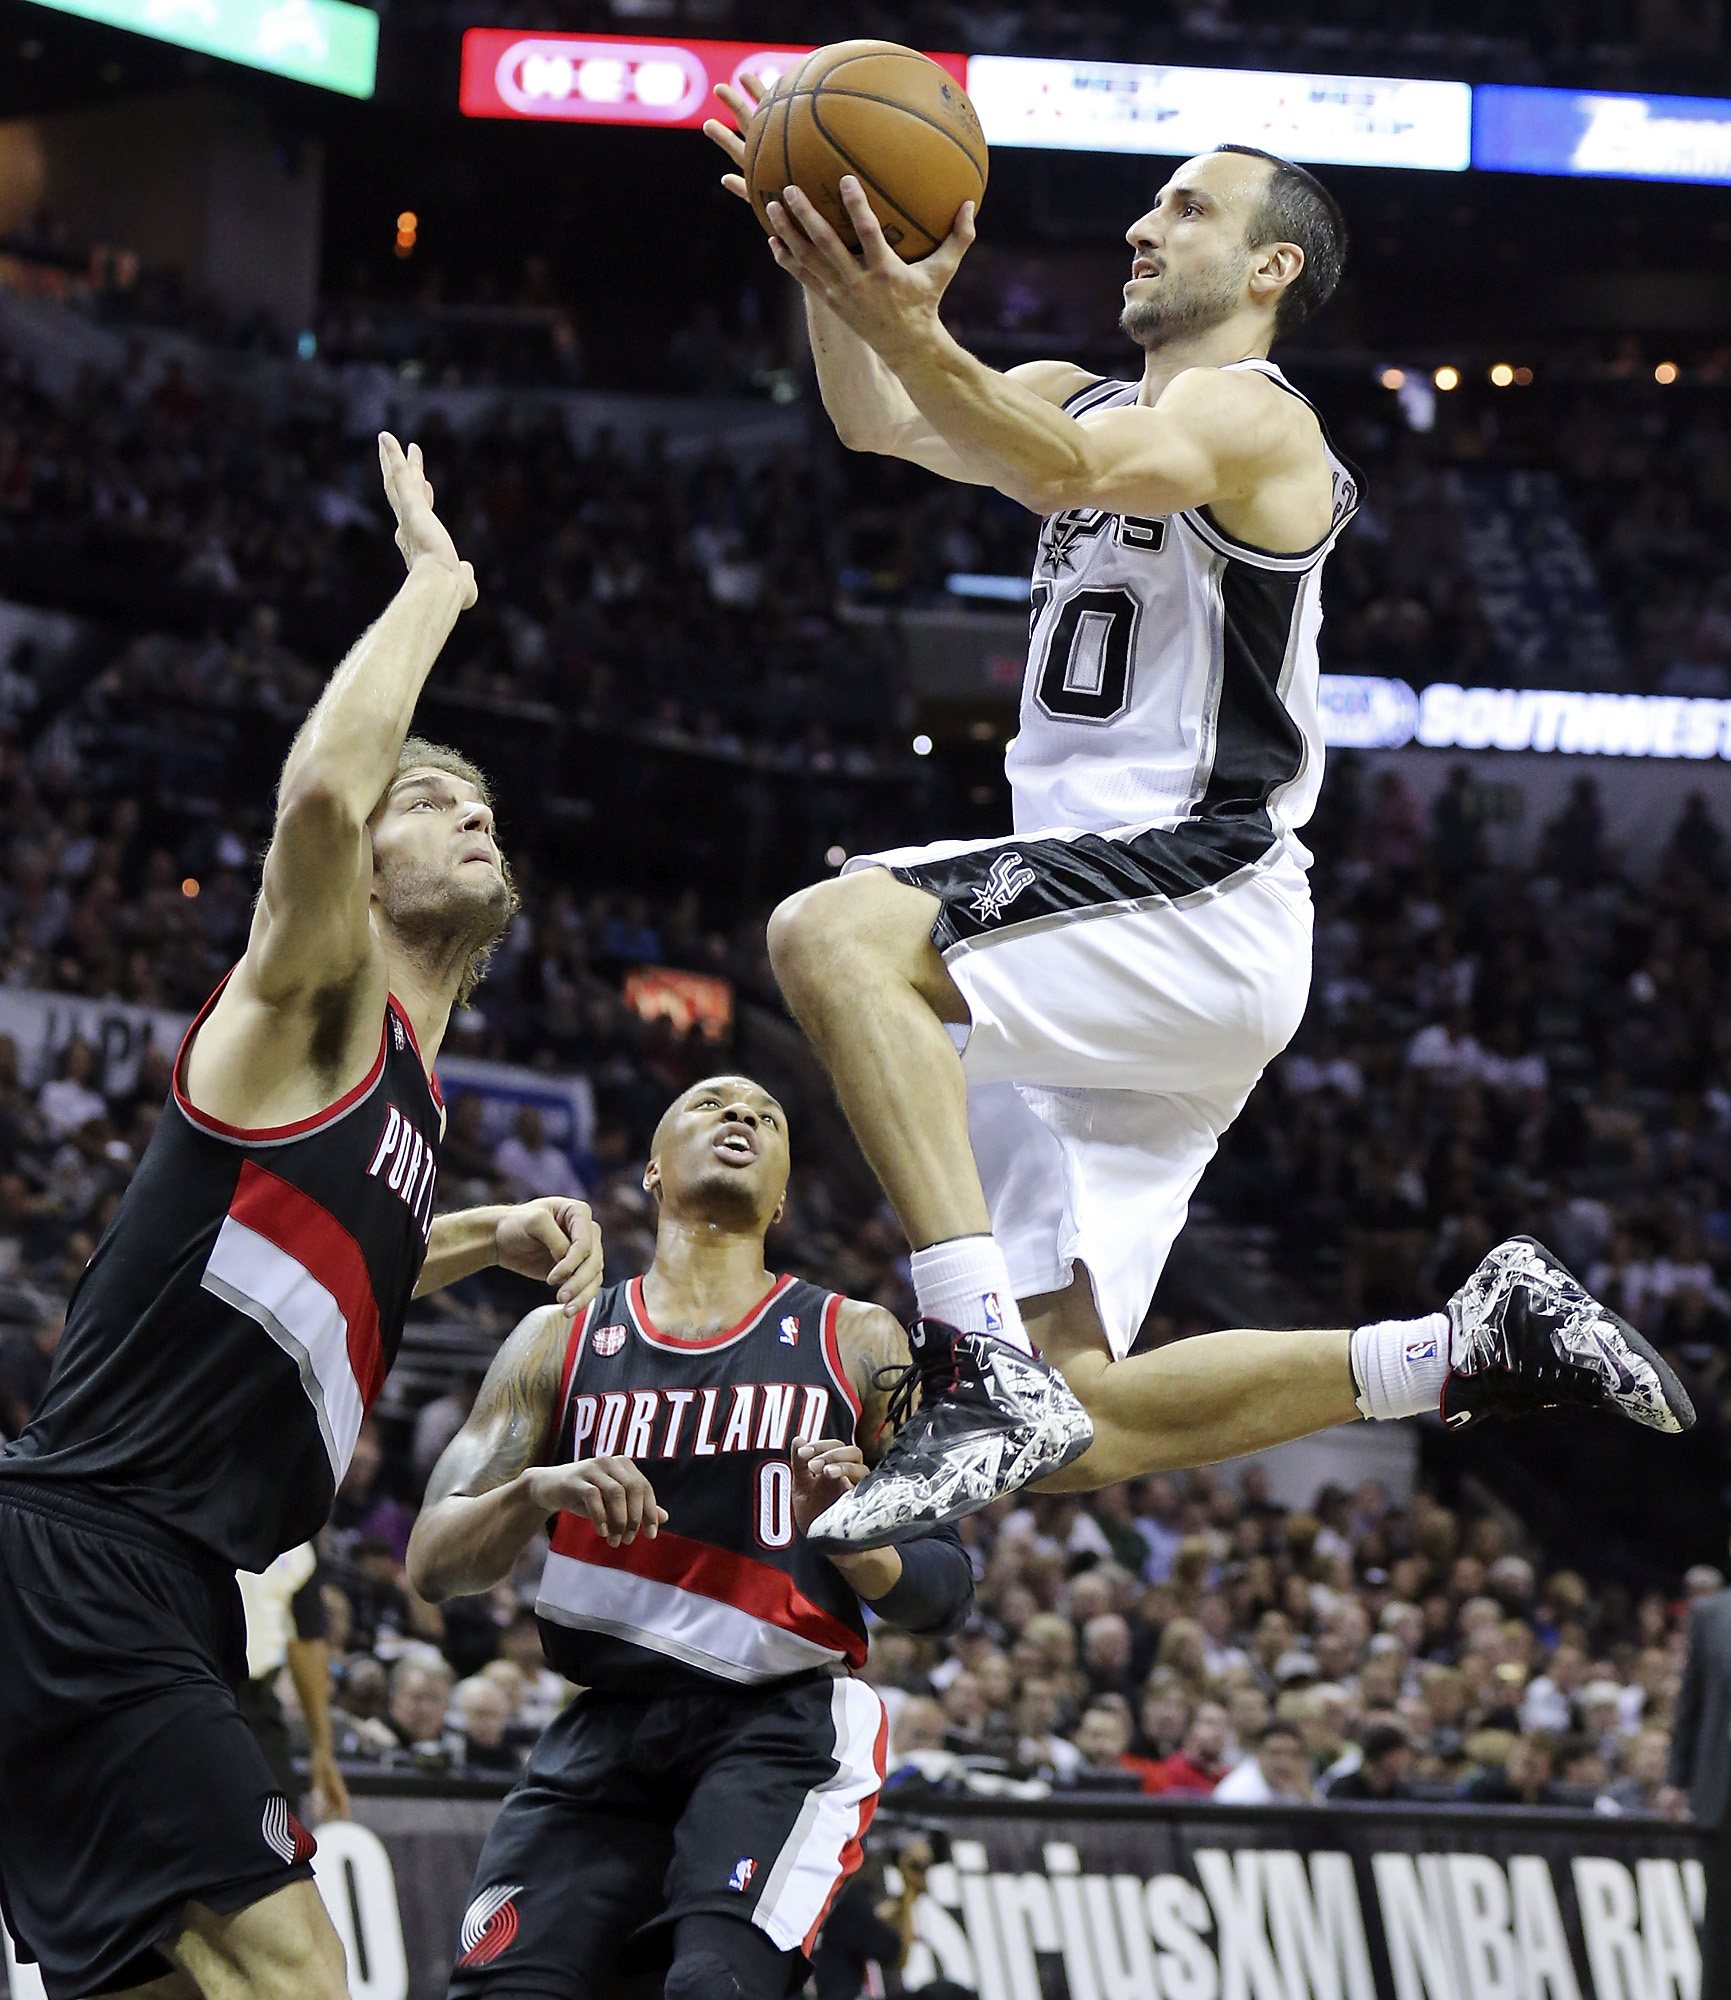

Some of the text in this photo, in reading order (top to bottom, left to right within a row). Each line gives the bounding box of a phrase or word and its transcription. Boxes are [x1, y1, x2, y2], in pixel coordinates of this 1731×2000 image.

[1031, 580, 1144, 728] 0
[573, 1382, 830, 1462] PORTLAND
[755, 1458, 794, 1551] 0
[1370, 1851, 1583, 2000] NBA
[1571, 1855, 1708, 2000] RA
